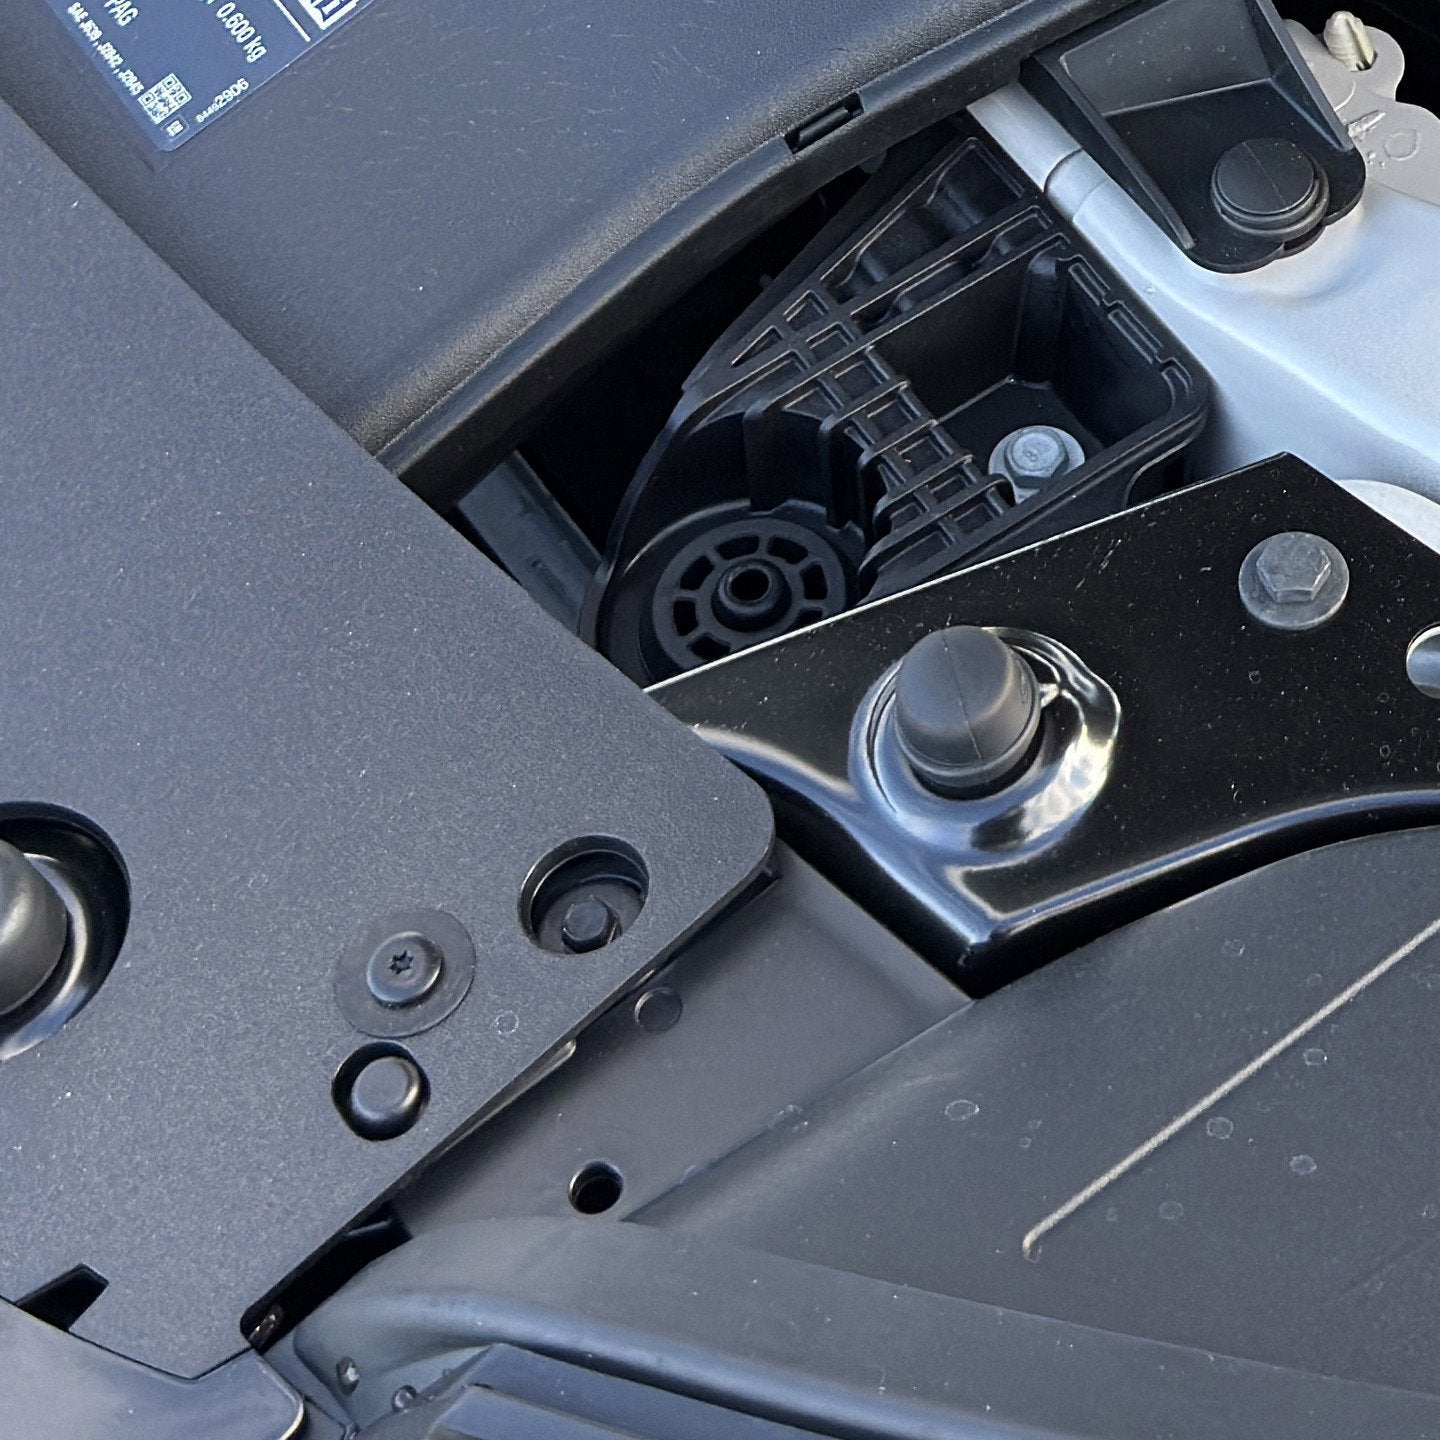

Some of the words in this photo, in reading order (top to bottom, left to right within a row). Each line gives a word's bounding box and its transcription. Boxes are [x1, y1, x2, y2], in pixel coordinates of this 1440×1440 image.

[68, 2, 88, 22] SAE
[216, 2, 255, 42] 0.600
[243, 36, 266, 63] kg
